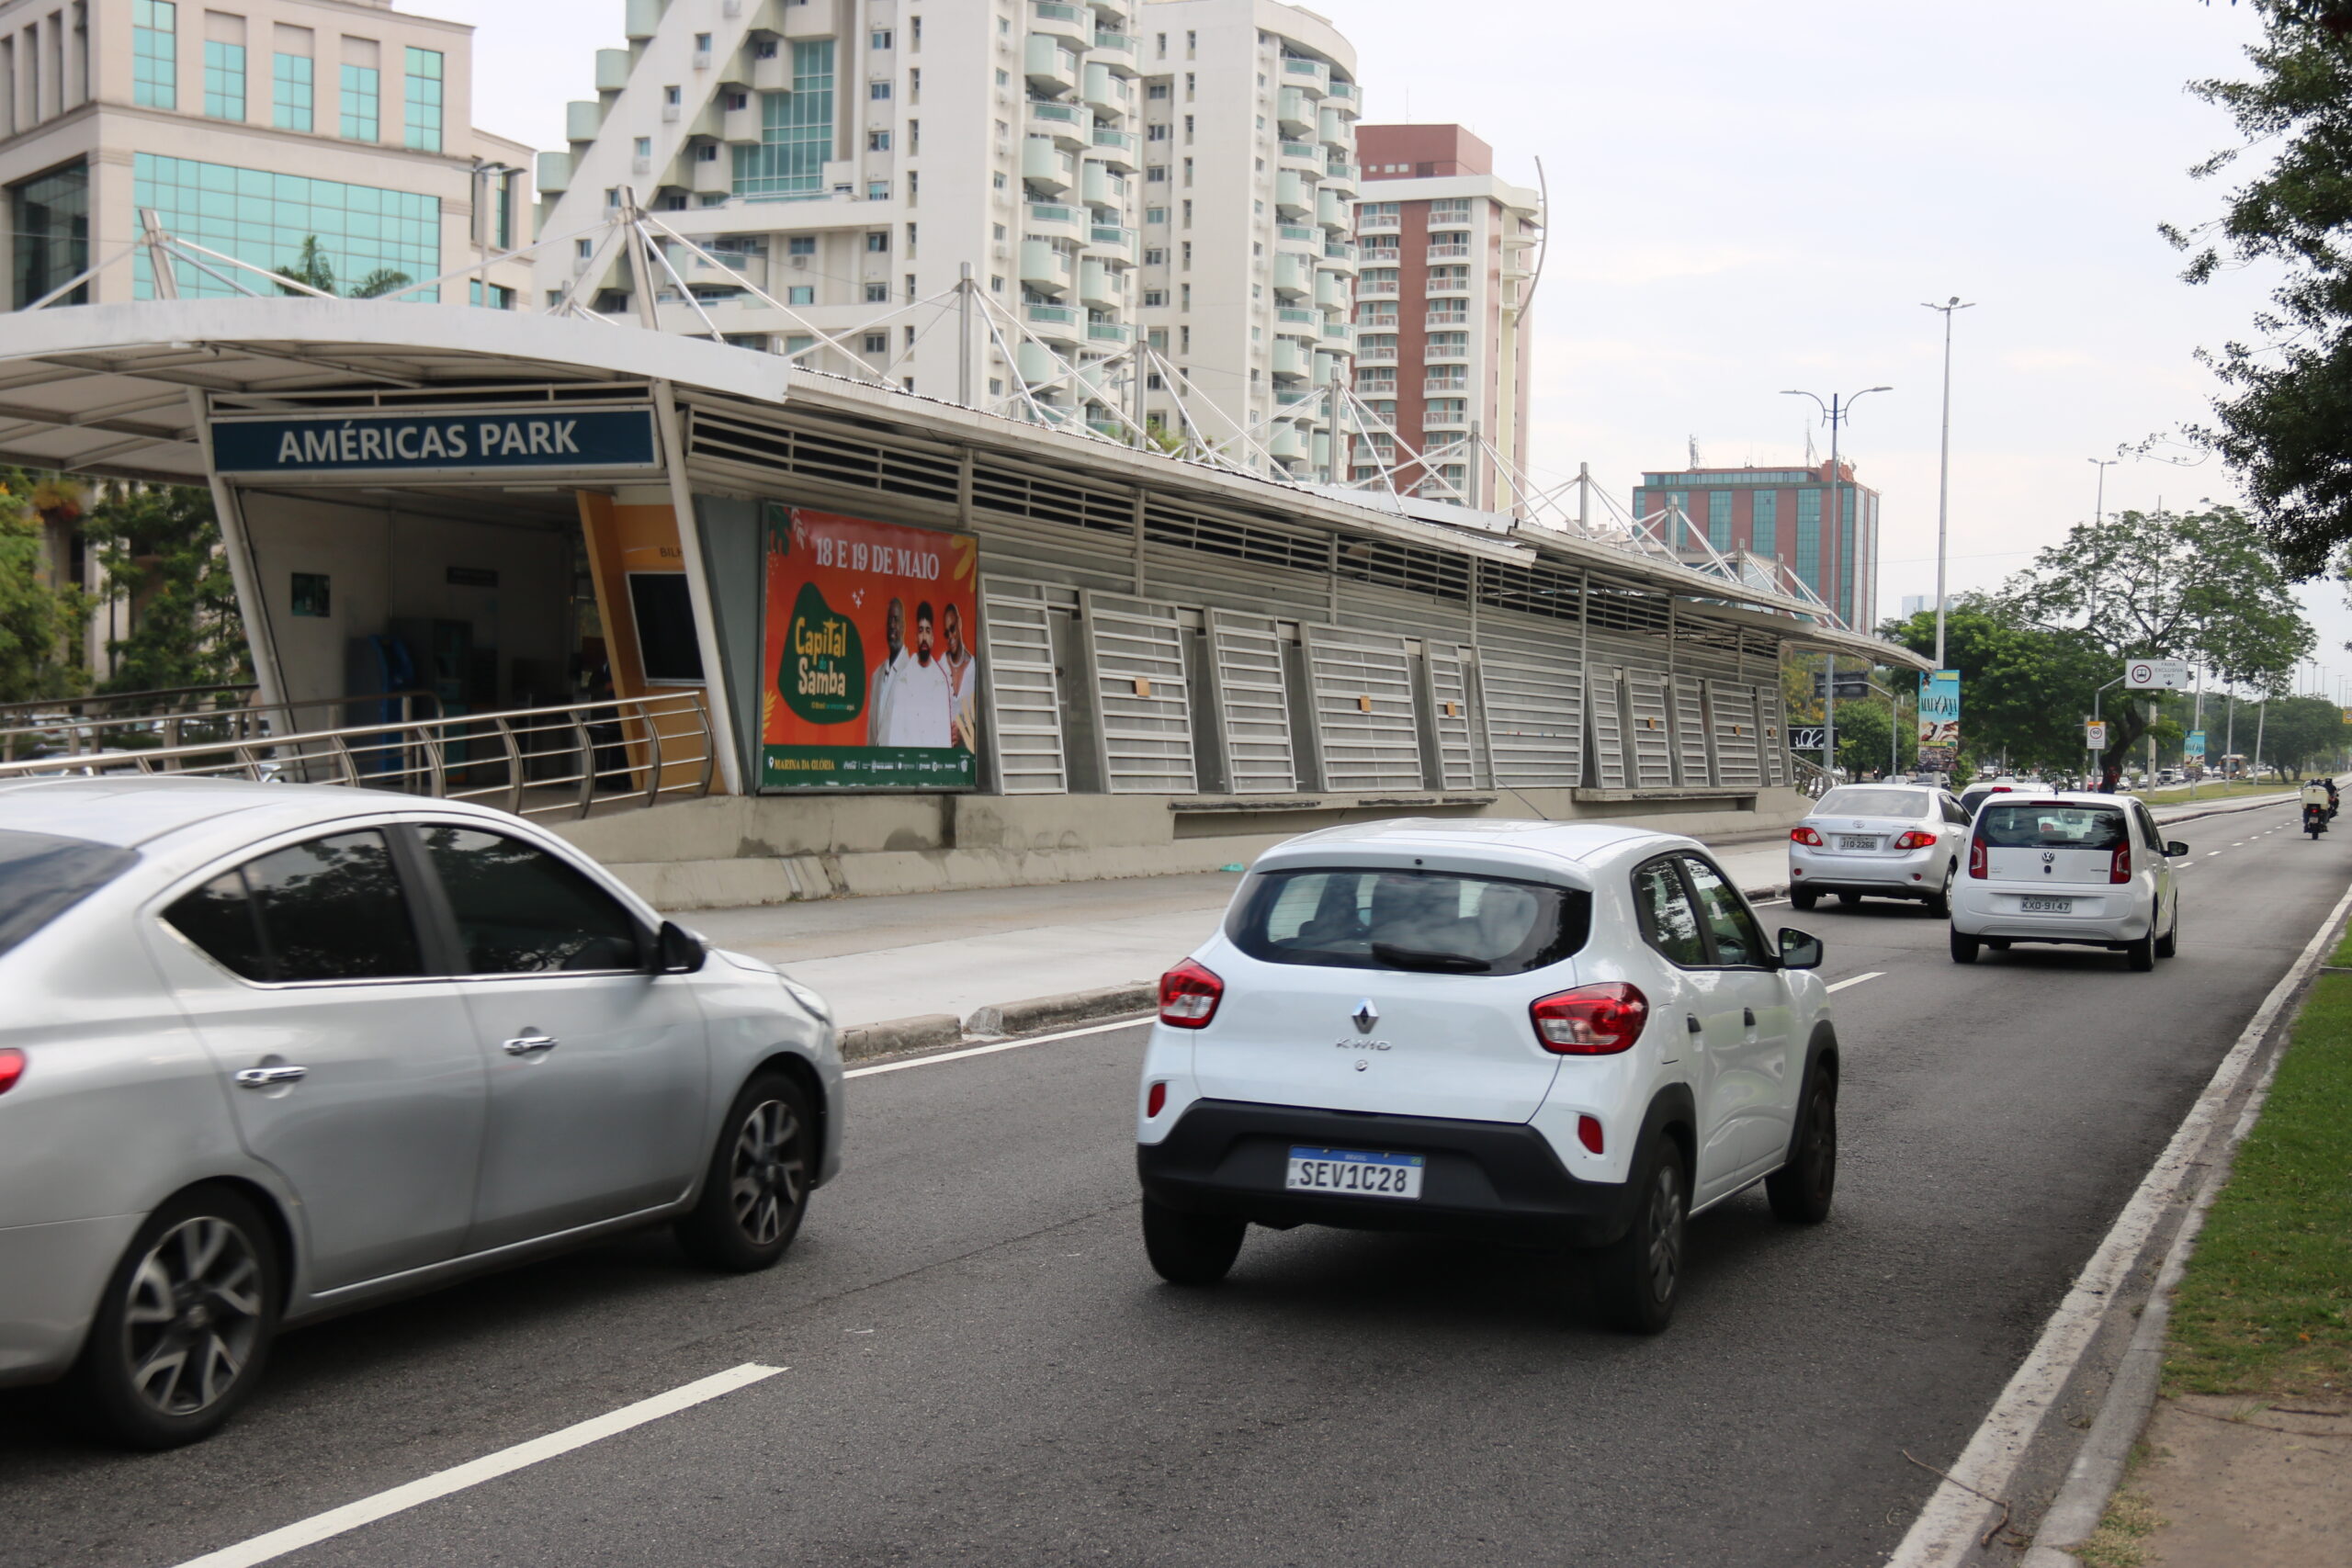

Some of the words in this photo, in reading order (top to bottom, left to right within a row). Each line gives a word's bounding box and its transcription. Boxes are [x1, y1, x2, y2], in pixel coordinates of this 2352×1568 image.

[277, 420, 468, 463] AMÉRICAS
[479, 420, 580, 457] PARK
[817, 537, 832, 566] 18
[837, 539, 848, 569] E
[852, 542, 868, 571] 19
[872, 545, 894, 575] DE
[897, 548, 940, 581] MAIO
[797, 656, 846, 697] Samba
[1335, 1037, 1393, 1052] KWID
[1299, 1161, 1408, 1192] SEV1C28
